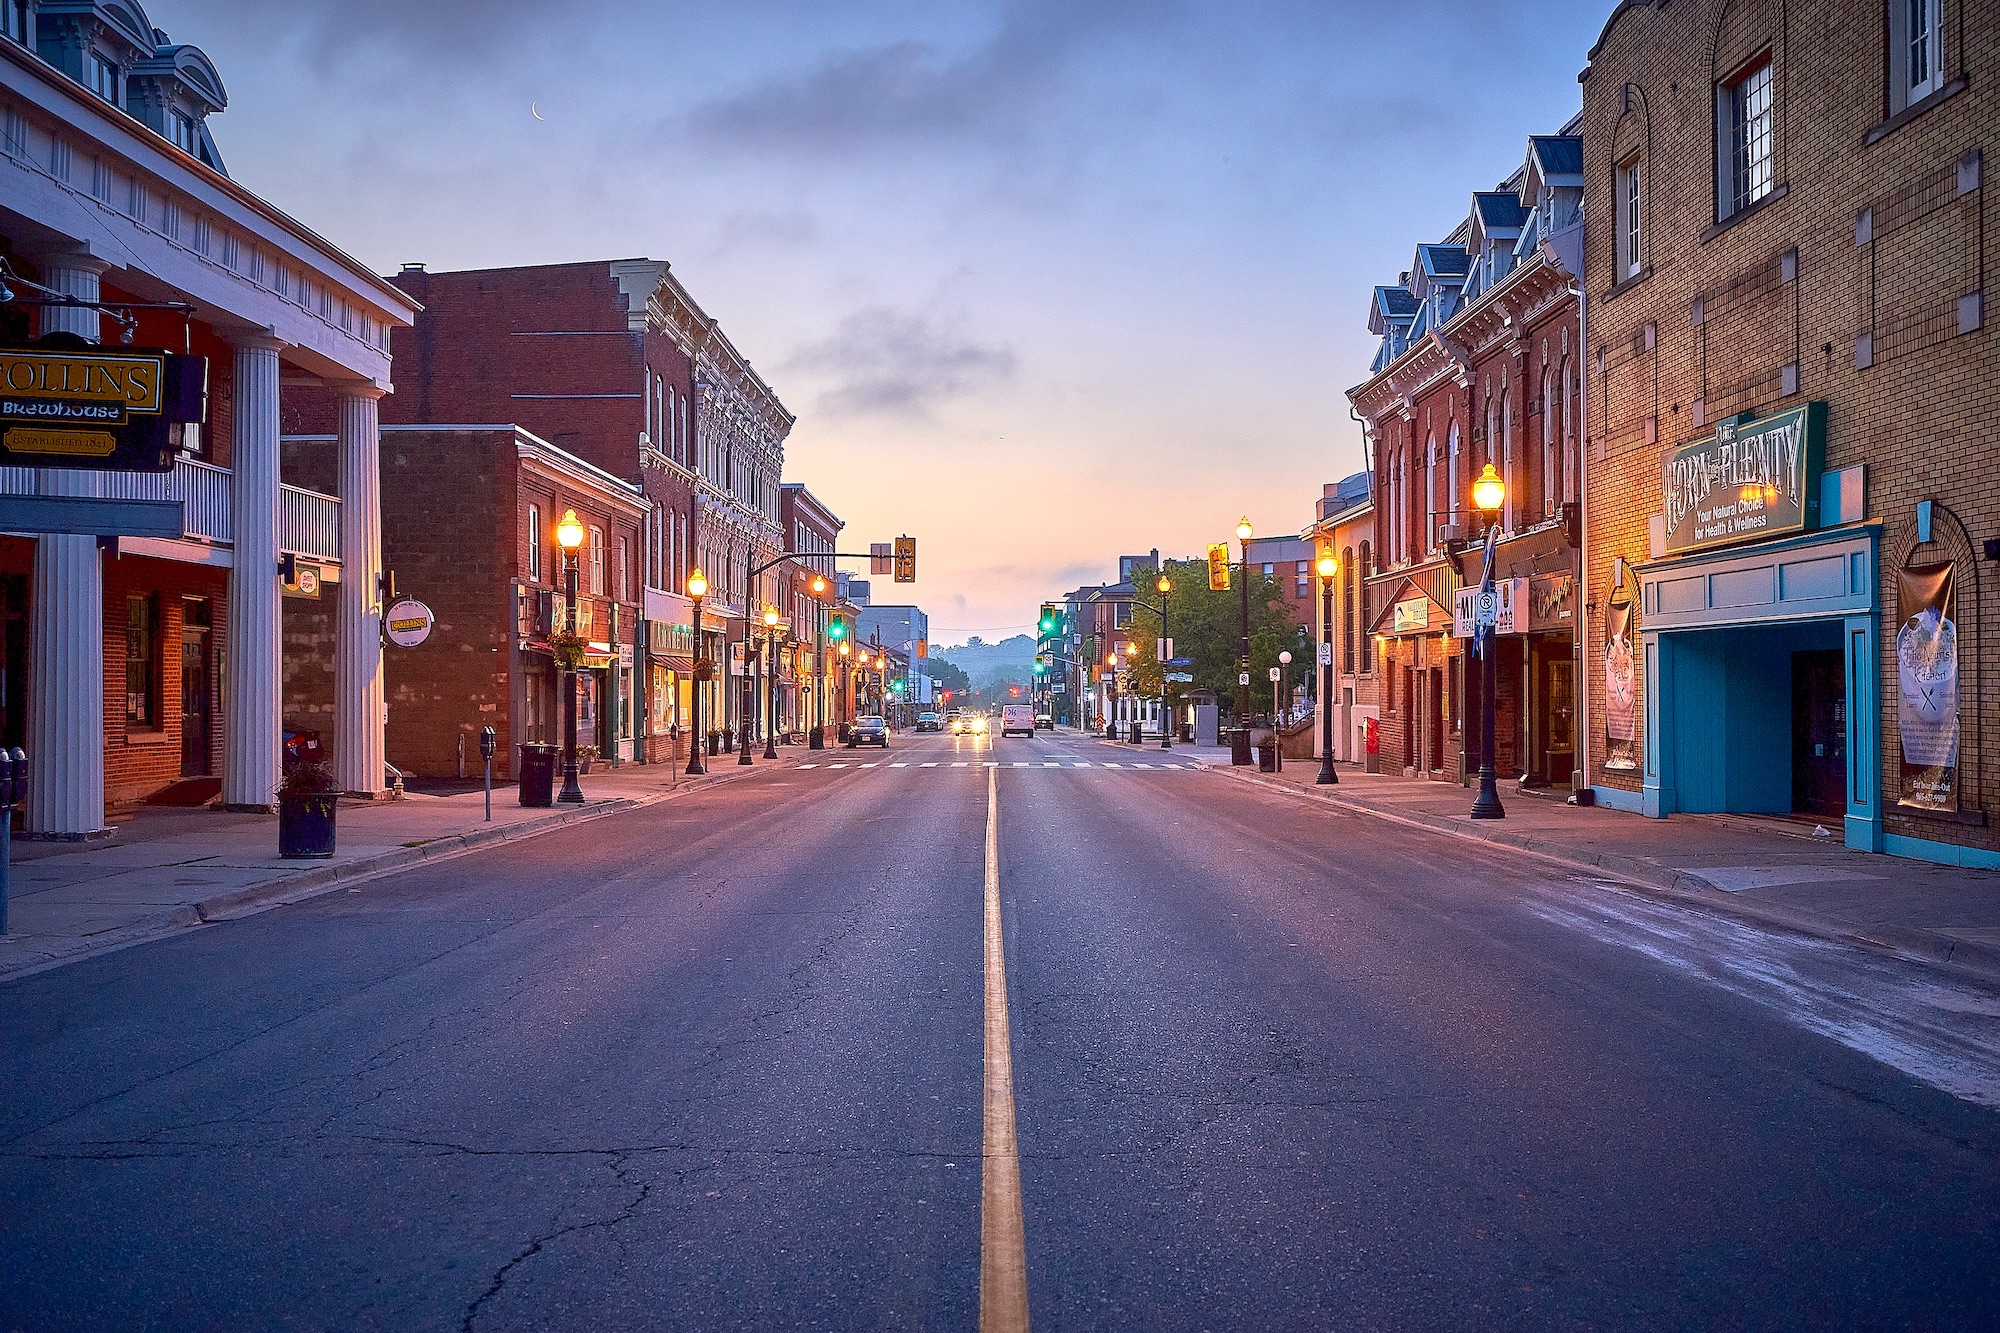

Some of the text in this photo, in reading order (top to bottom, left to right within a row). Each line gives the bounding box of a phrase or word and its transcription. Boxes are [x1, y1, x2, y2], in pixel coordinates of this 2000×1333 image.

[0, 361, 149, 401] OLLINS
[13, 433, 108, 448] ESTABLISHED 1841
[1661, 452, 1711, 541] HORN
[1717, 411, 1804, 508] PLENTY
[1696, 498, 1764, 524] Your Natural Choice
[1694, 513, 1767, 540] for Health & Wellness
[657, 630, 694, 651] AMARETTO
